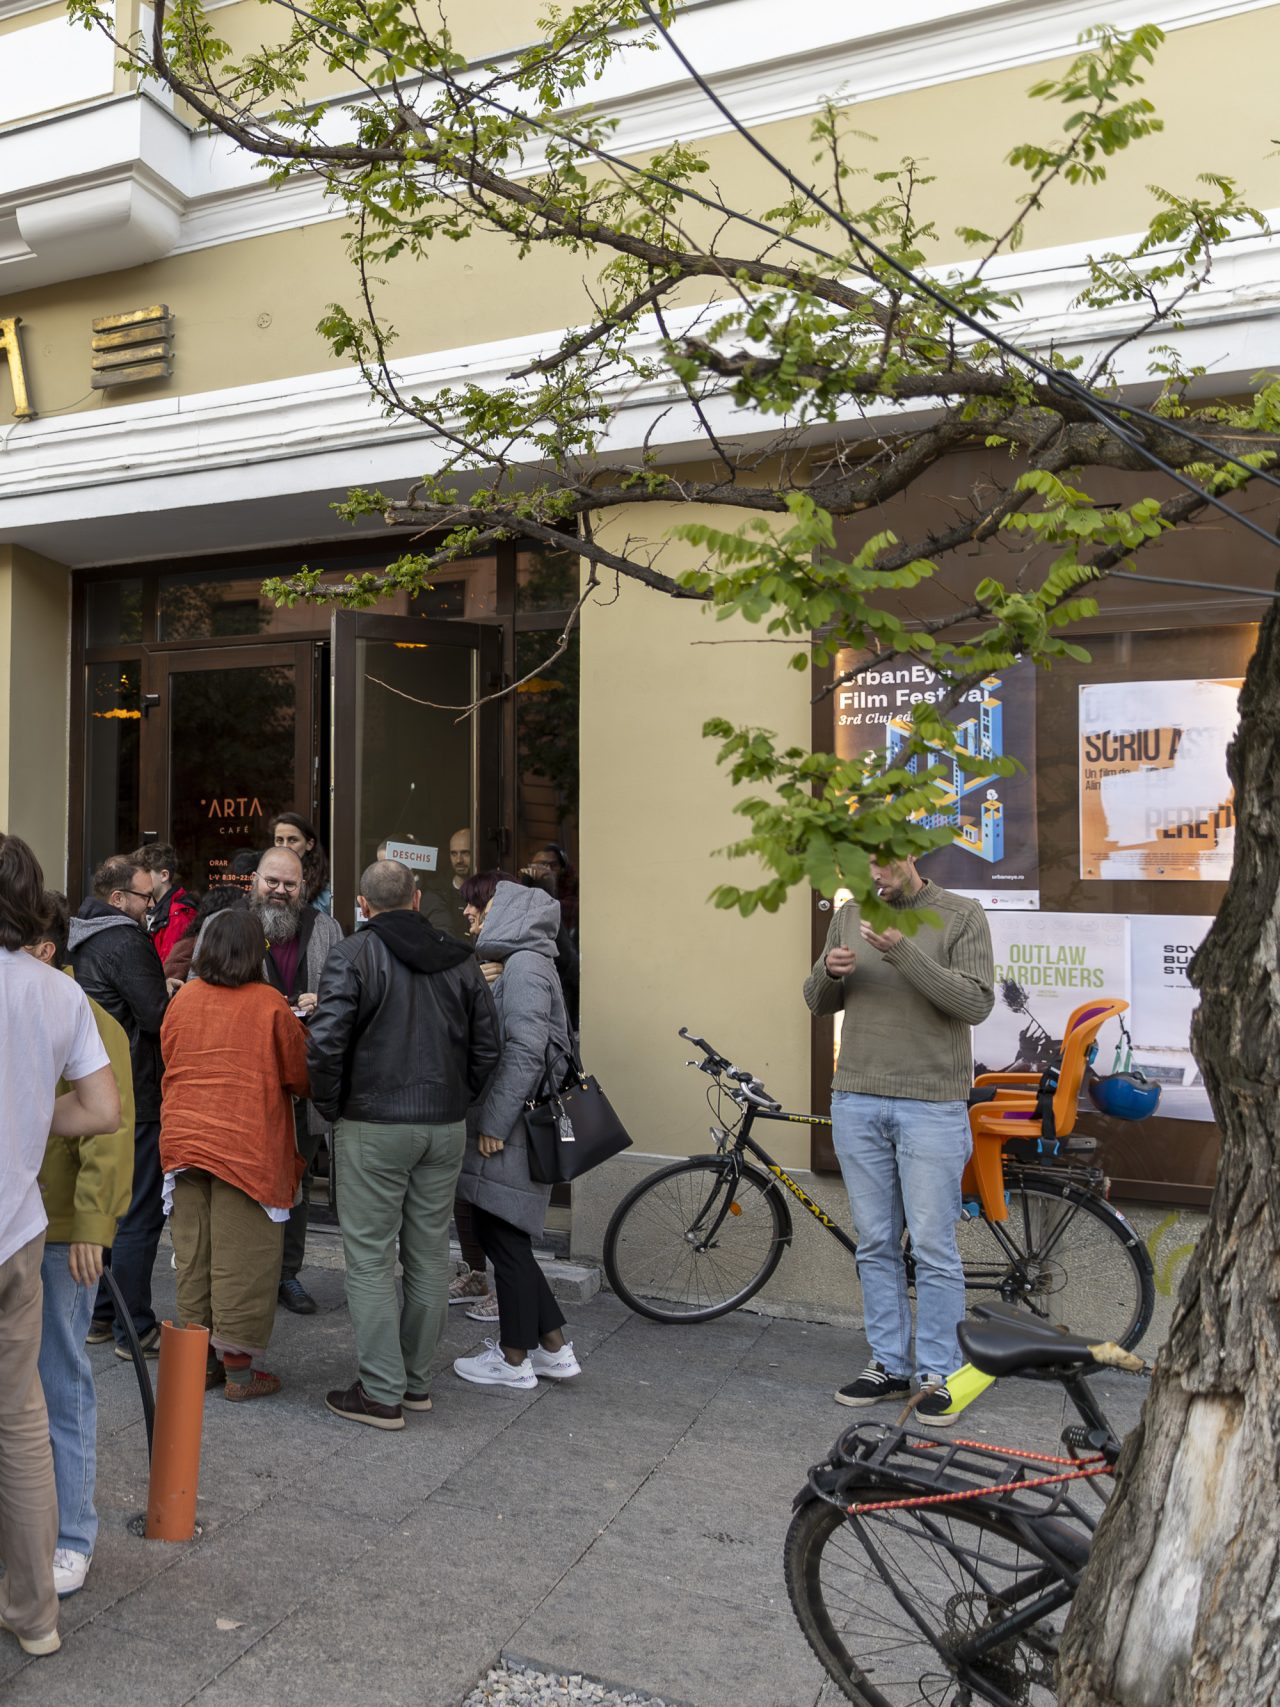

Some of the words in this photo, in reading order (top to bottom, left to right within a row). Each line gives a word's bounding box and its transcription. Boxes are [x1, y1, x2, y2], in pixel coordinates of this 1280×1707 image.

[839, 691, 888, 710] Film
[838, 713, 862, 726] 3rd
[865, 712, 893, 726] Cluj
[1085, 728, 1161, 763] SCRIU
[1085, 769, 1097, 779] Un
[219, 825, 249, 835] CAFÉ
[209, 859, 228, 867] ORAR
[392, 849, 432, 863] DESCHIS
[1009, 943, 1087, 966] OUTLAW
[1163, 944, 1199, 954] SOV
[993, 964, 1105, 988] GARDENERS
[789, 1114, 819, 1125] RED
